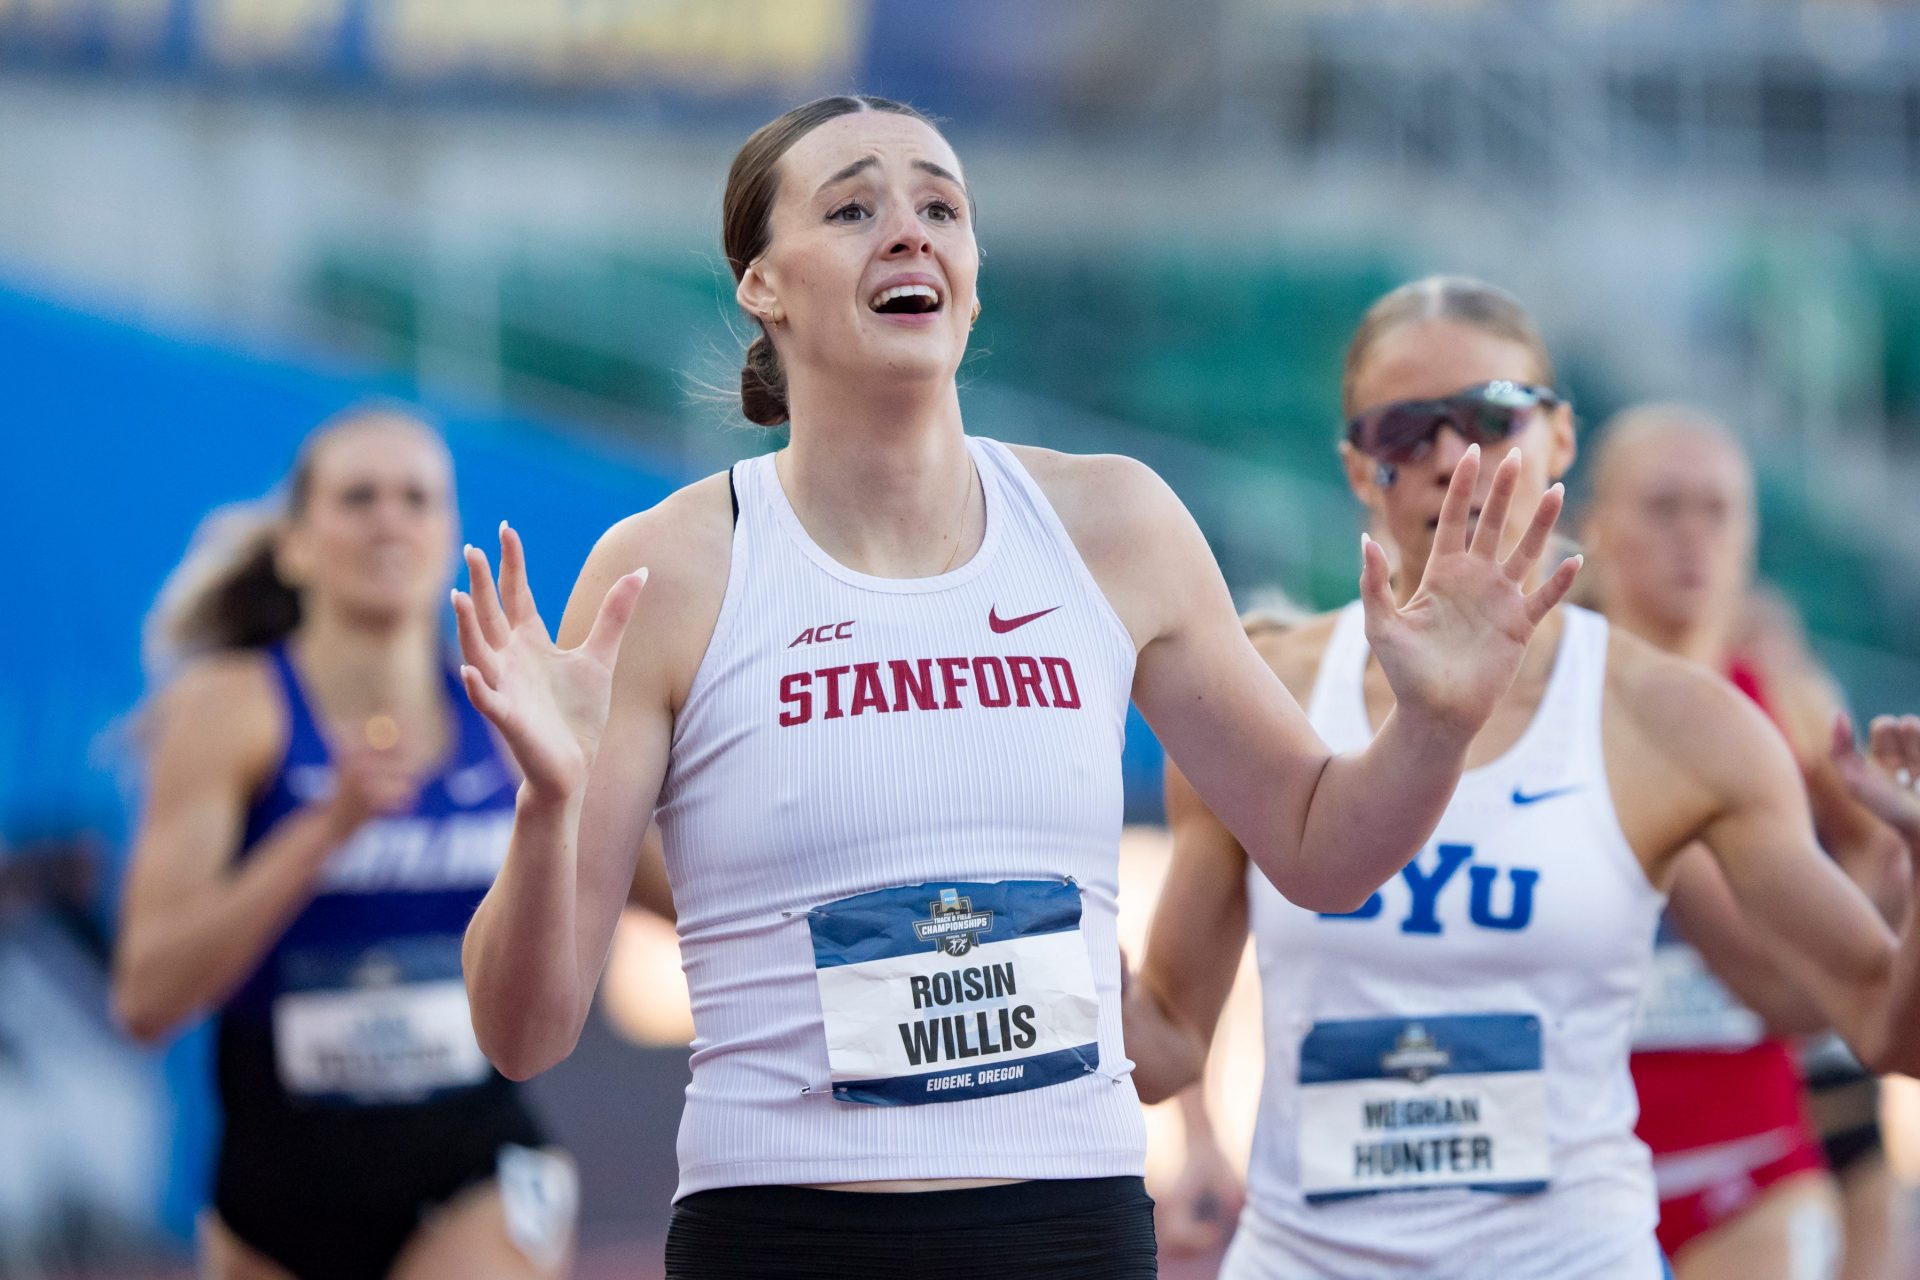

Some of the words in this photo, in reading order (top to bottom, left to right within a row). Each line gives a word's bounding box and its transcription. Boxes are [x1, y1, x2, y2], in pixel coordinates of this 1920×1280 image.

[787, 620, 856, 648] ACC
[778, 655, 1082, 728] STANFORD
[1316, 843, 1540, 935] YU
[921, 917, 987, 935] CHAMPIONSHIPS
[934, 916, 951, 925] TRACK
[910, 962, 1017, 1009] ROISIN
[898, 1005, 1037, 1066] WILLIS
[926, 1073, 975, 1092] EUGENE,
[978, 1065, 1024, 1085] OREGON
[1354, 1136, 1494, 1177] HUNTER
